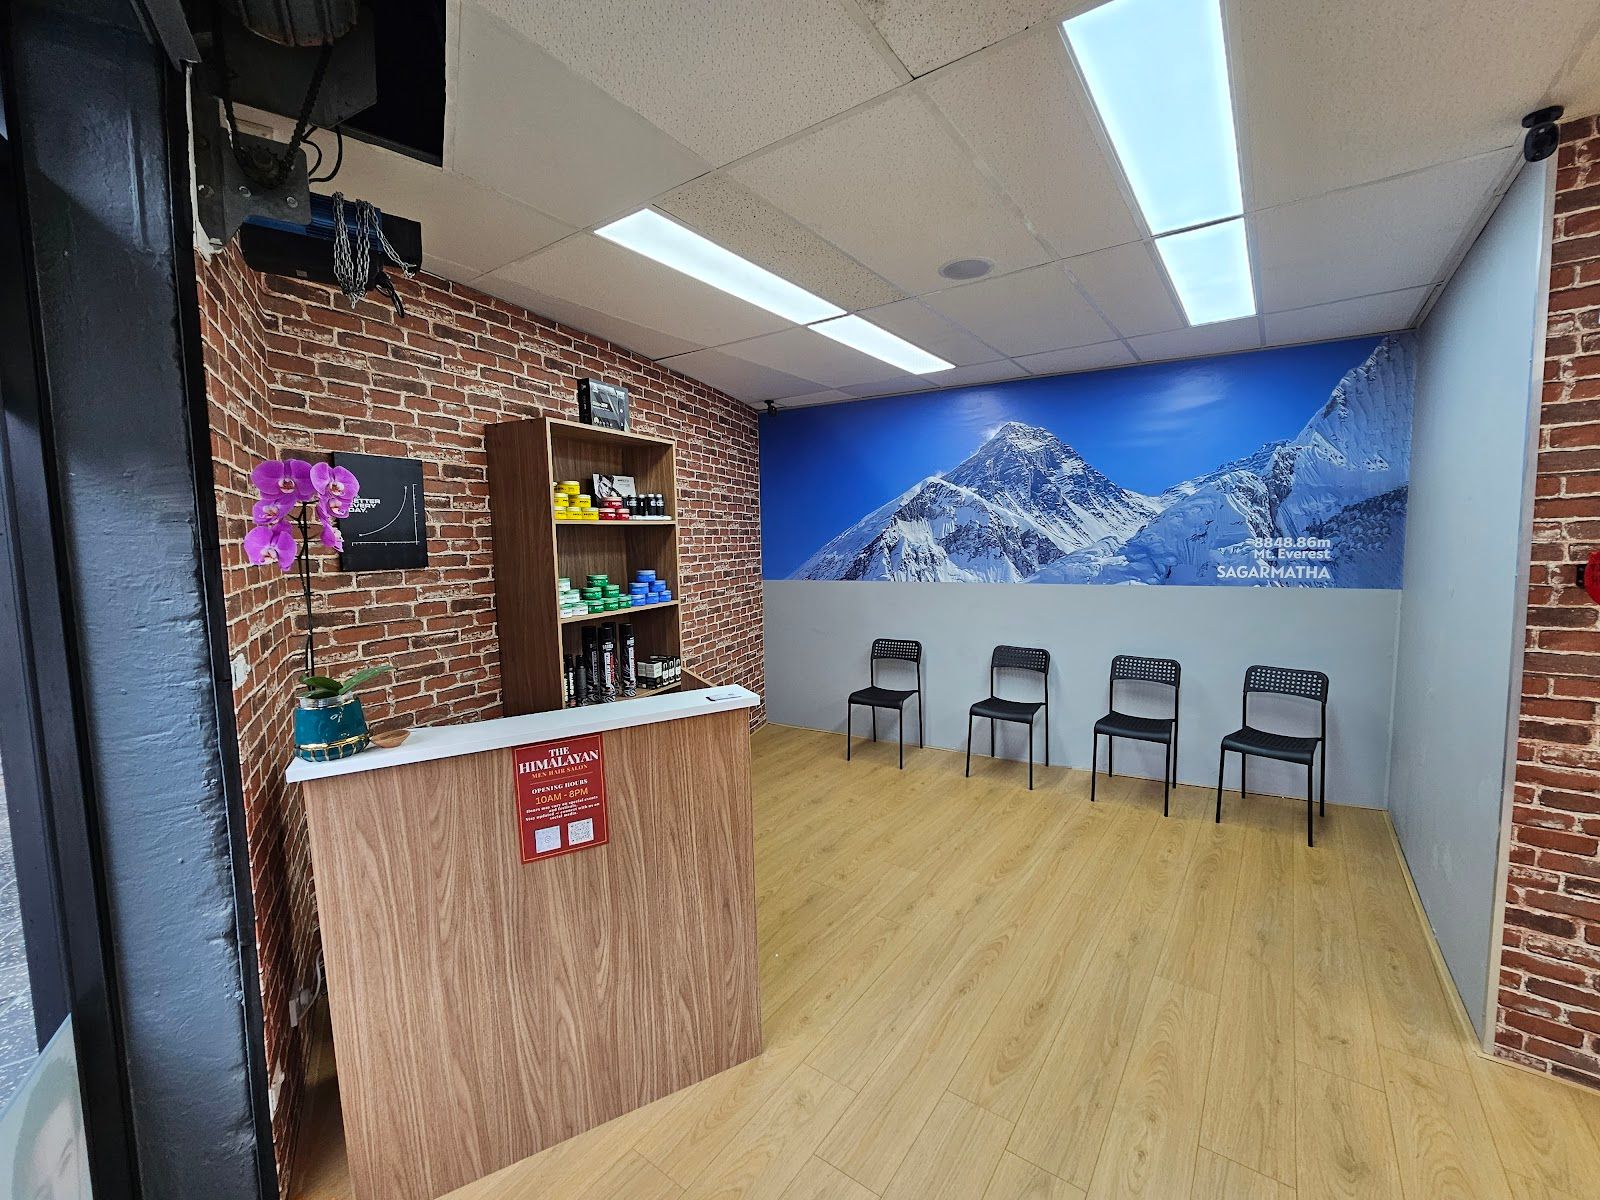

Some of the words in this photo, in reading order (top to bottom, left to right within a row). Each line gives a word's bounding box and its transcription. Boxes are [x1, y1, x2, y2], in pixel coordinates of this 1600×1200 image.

[1254, 536, 1331, 549] 8848.86m
[1254, 548, 1275, 559] Mt.
[1277, 548, 1331, 559] Everest
[1216, 565, 1331, 579] SAGARMATHA
[549, 747, 569, 757] THE
[519, 750, 598, 773] HIMALAYAN
[548, 768, 566, 776] HAIR
[566, 764, 588, 772] SALON
[532, 784, 563, 794] OPENING
[565, 779, 588, 787] HOURS
[536, 793, 562, 804] 10AM
[569, 788, 588, 797] 8PM
